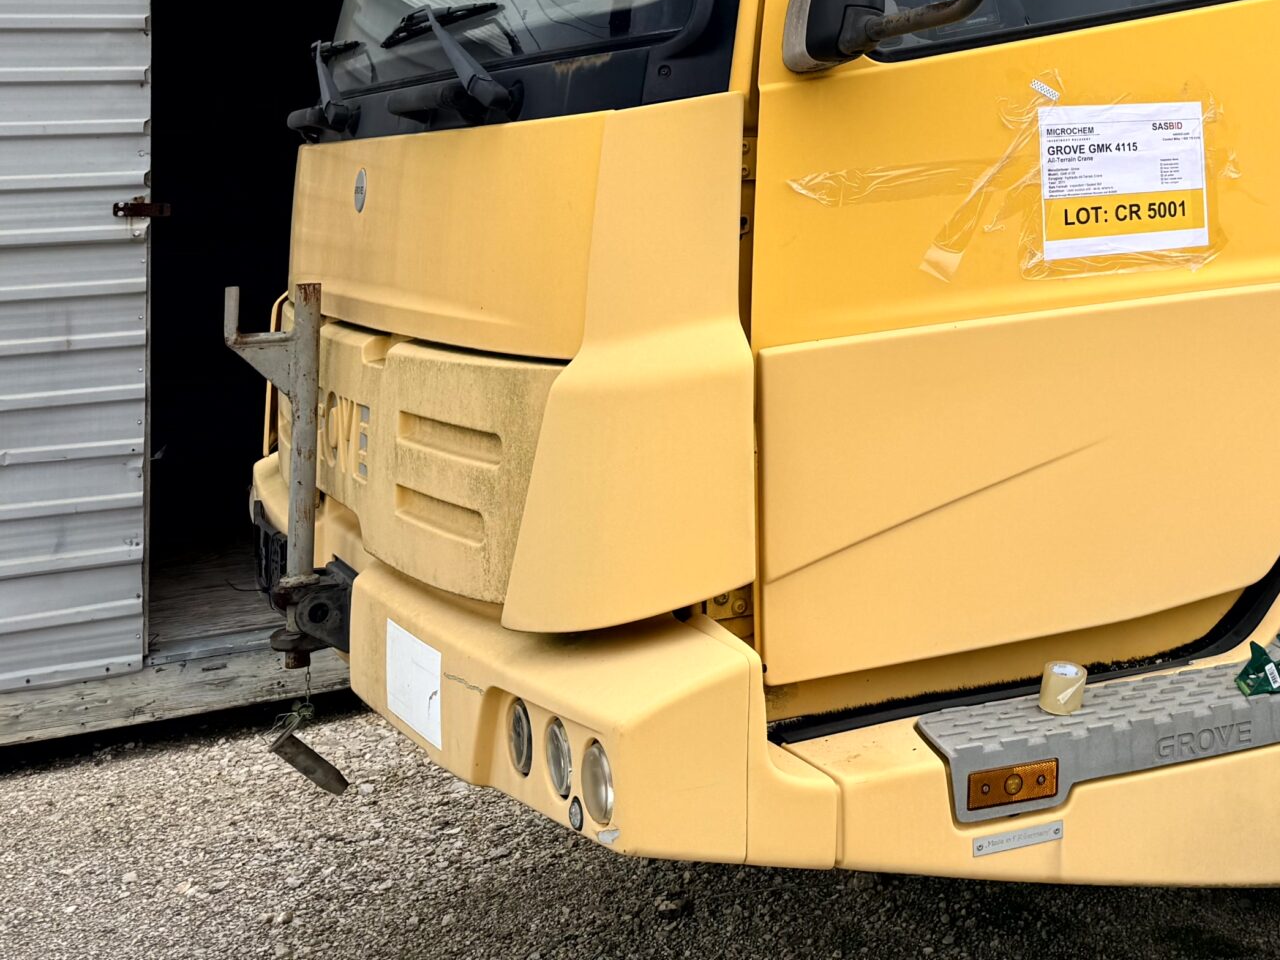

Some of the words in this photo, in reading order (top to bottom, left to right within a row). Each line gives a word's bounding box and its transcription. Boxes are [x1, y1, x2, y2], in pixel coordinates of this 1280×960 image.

[1046, 126, 1094, 136] MICROCHEM
[1047, 144, 1086, 156] GROVE
[1088, 143, 1113, 154] GMK
[1114, 142, 1138, 153] 4115
[1064, 206, 1108, 226] LOT:
[1114, 203, 1142, 222] CR
[1147, 200, 1186, 220] 5001
[1154, 720, 1252, 760] GROVE
